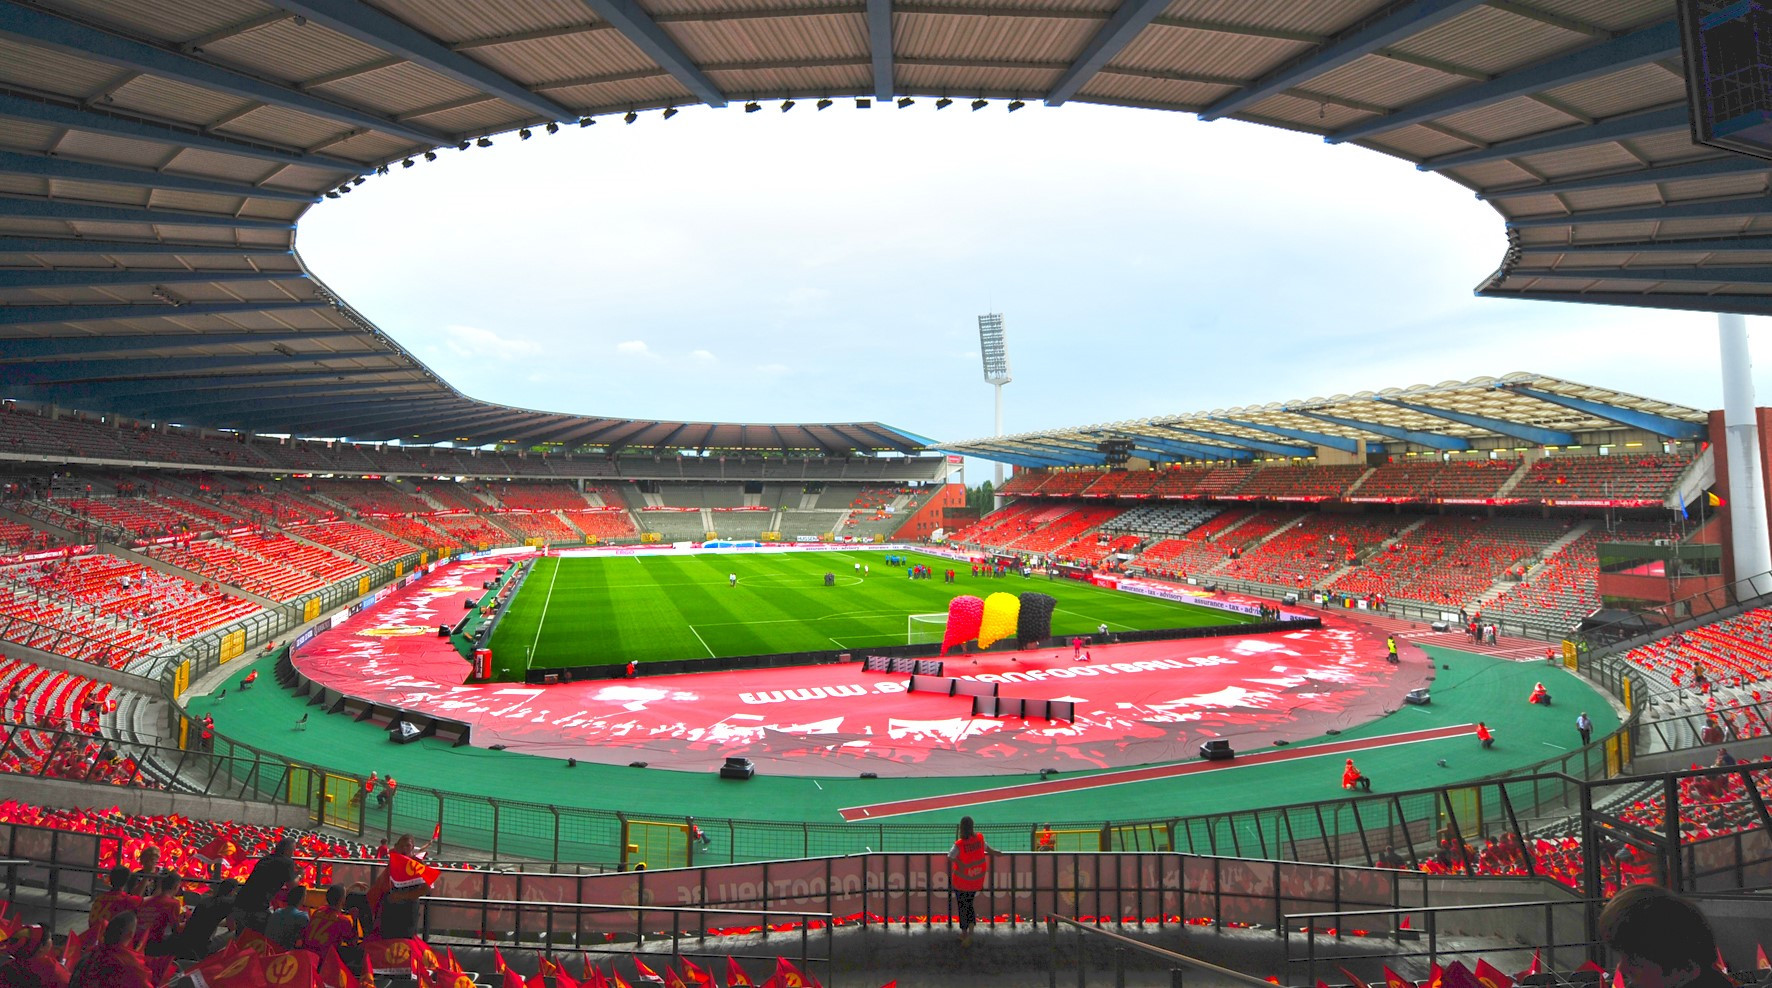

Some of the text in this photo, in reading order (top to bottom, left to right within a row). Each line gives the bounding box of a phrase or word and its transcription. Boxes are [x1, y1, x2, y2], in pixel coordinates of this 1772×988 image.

[1159, 591, 1182, 600] advisory
[1194, 598, 1224, 608] assurance
[1229, 603, 1239, 611] tax
